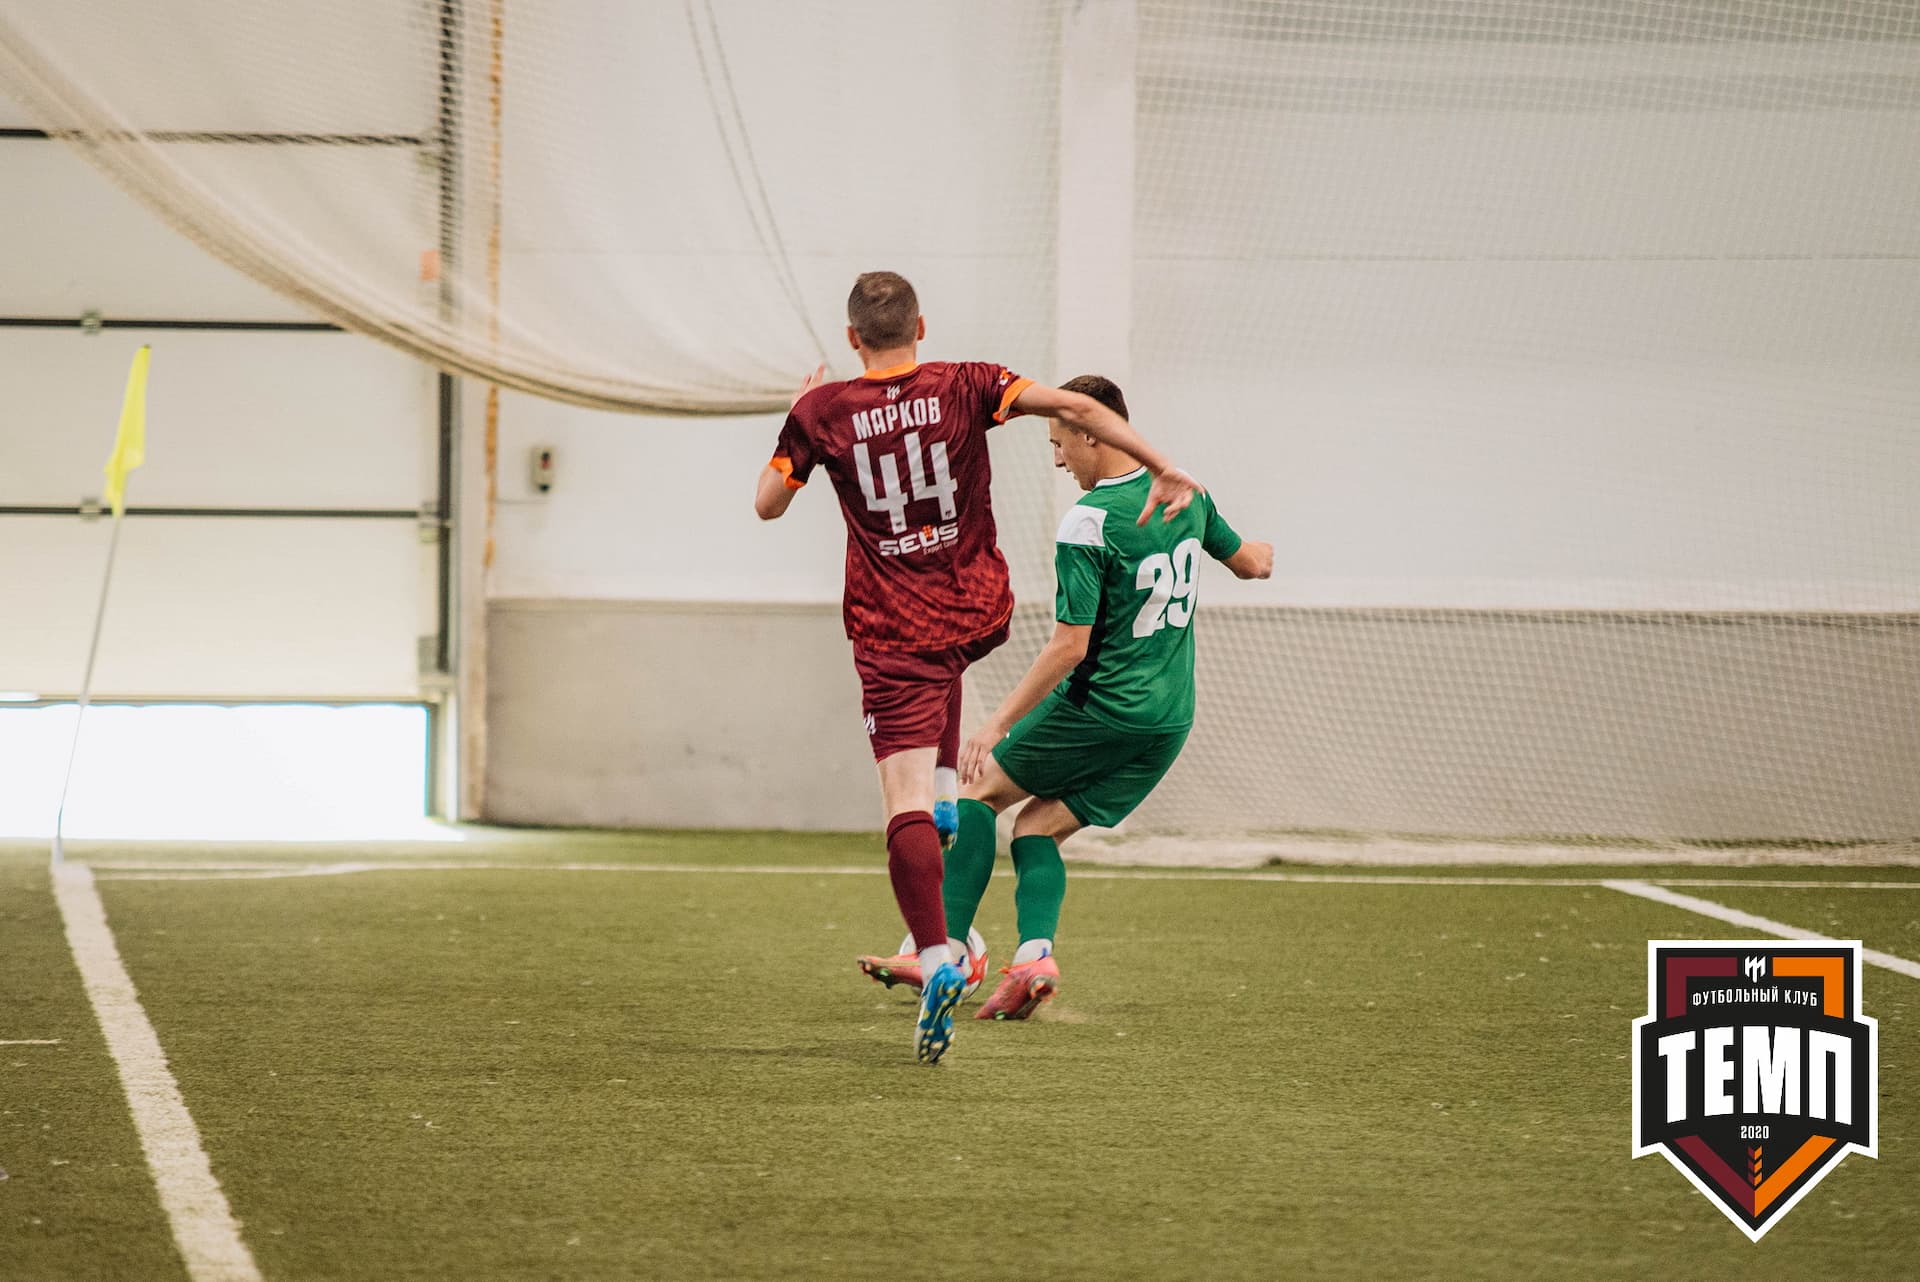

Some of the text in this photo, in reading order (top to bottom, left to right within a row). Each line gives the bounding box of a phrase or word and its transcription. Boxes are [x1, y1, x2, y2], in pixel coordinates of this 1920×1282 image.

[852, 397, 941, 440] МАРКОВ
[853, 432, 957, 535] 44
[879, 522, 958, 556] SEUS
[1133, 538, 1200, 638] 29
